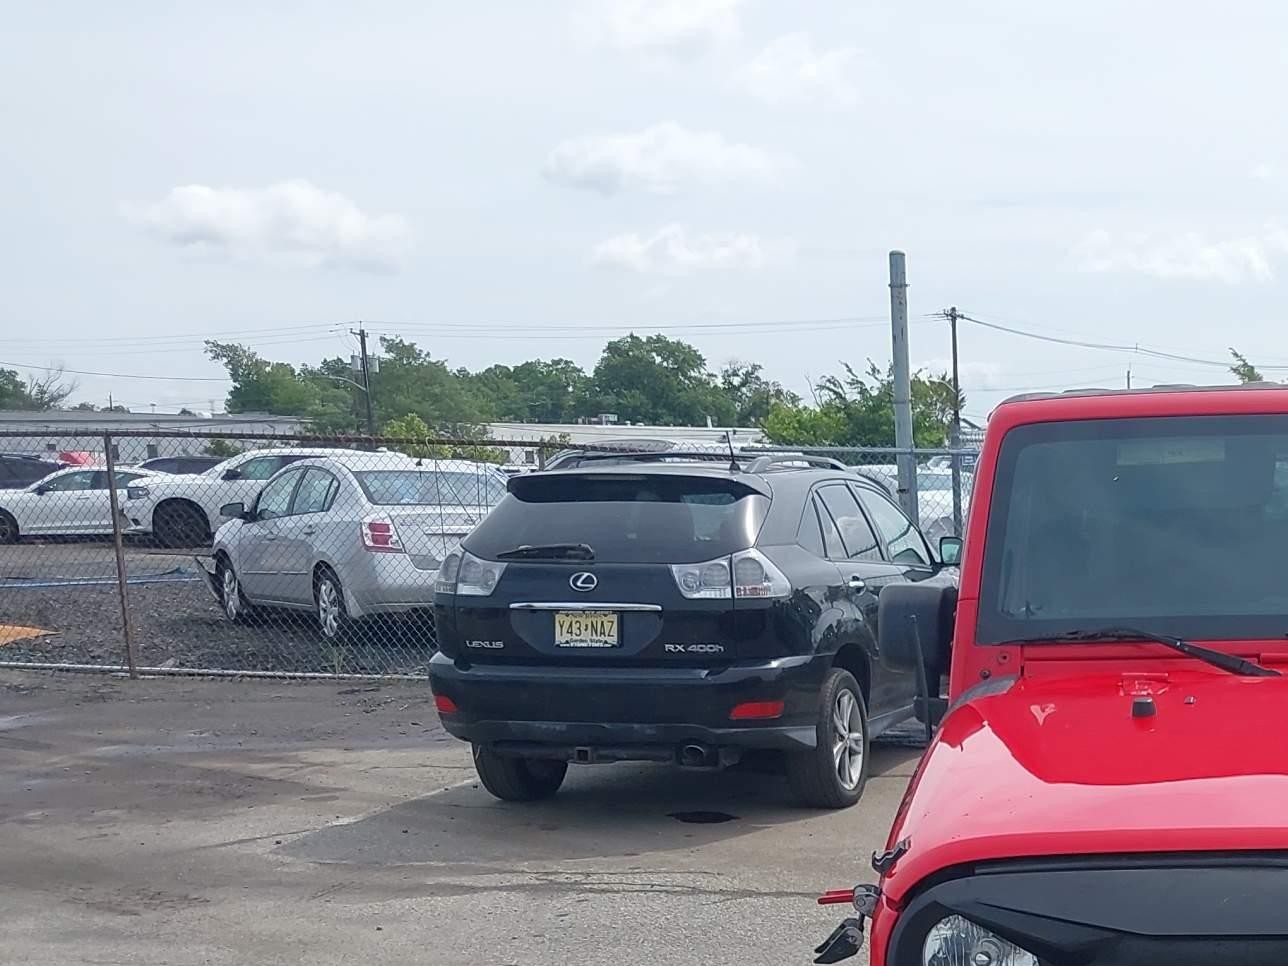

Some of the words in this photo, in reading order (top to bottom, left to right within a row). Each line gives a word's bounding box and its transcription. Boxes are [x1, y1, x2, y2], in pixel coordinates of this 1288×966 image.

[465, 640, 504, 649] LEXUS
[664, 643, 686, 652] RX
[687, 643, 725, 653] 400h
